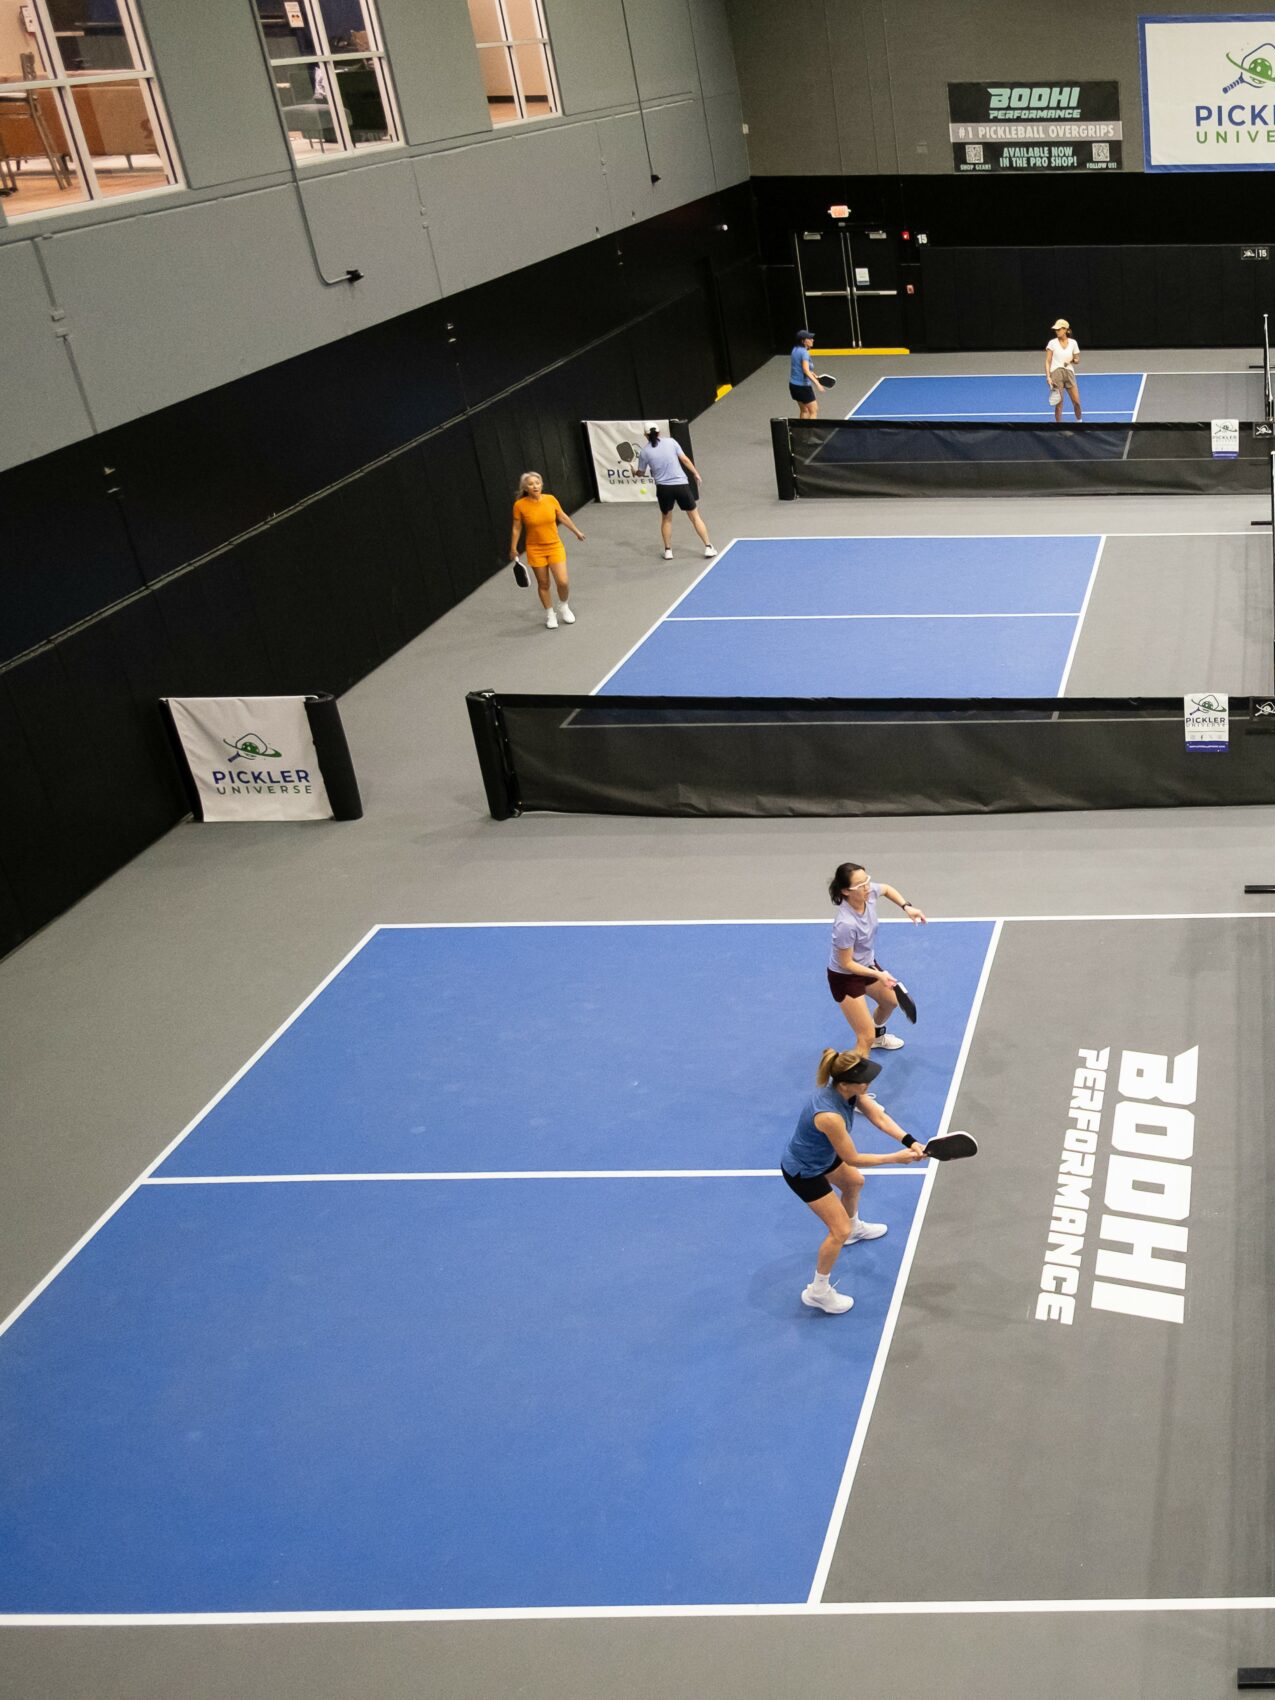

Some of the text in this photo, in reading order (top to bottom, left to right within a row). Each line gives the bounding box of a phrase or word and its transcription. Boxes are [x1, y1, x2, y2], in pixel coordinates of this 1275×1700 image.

[987, 87, 1080, 108] BODHI
[989, 109, 1081, 119] PERFORMANCE
[958, 125, 1114, 138] #1 PICKLEBALL OVERGRIPS
[1003, 146, 1073, 157] AVAILABLE NOW
[1000, 156, 1077, 167] IN THE PRO SHOP!
[917, 234, 928, 244] 15
[212, 769, 310, 784] PICKLER
[216, 785, 312, 795] UNIVERSE
[1035, 1046, 1110, 1325] PERFORMANCE
[1091, 1045, 1199, 1324] BODHI
